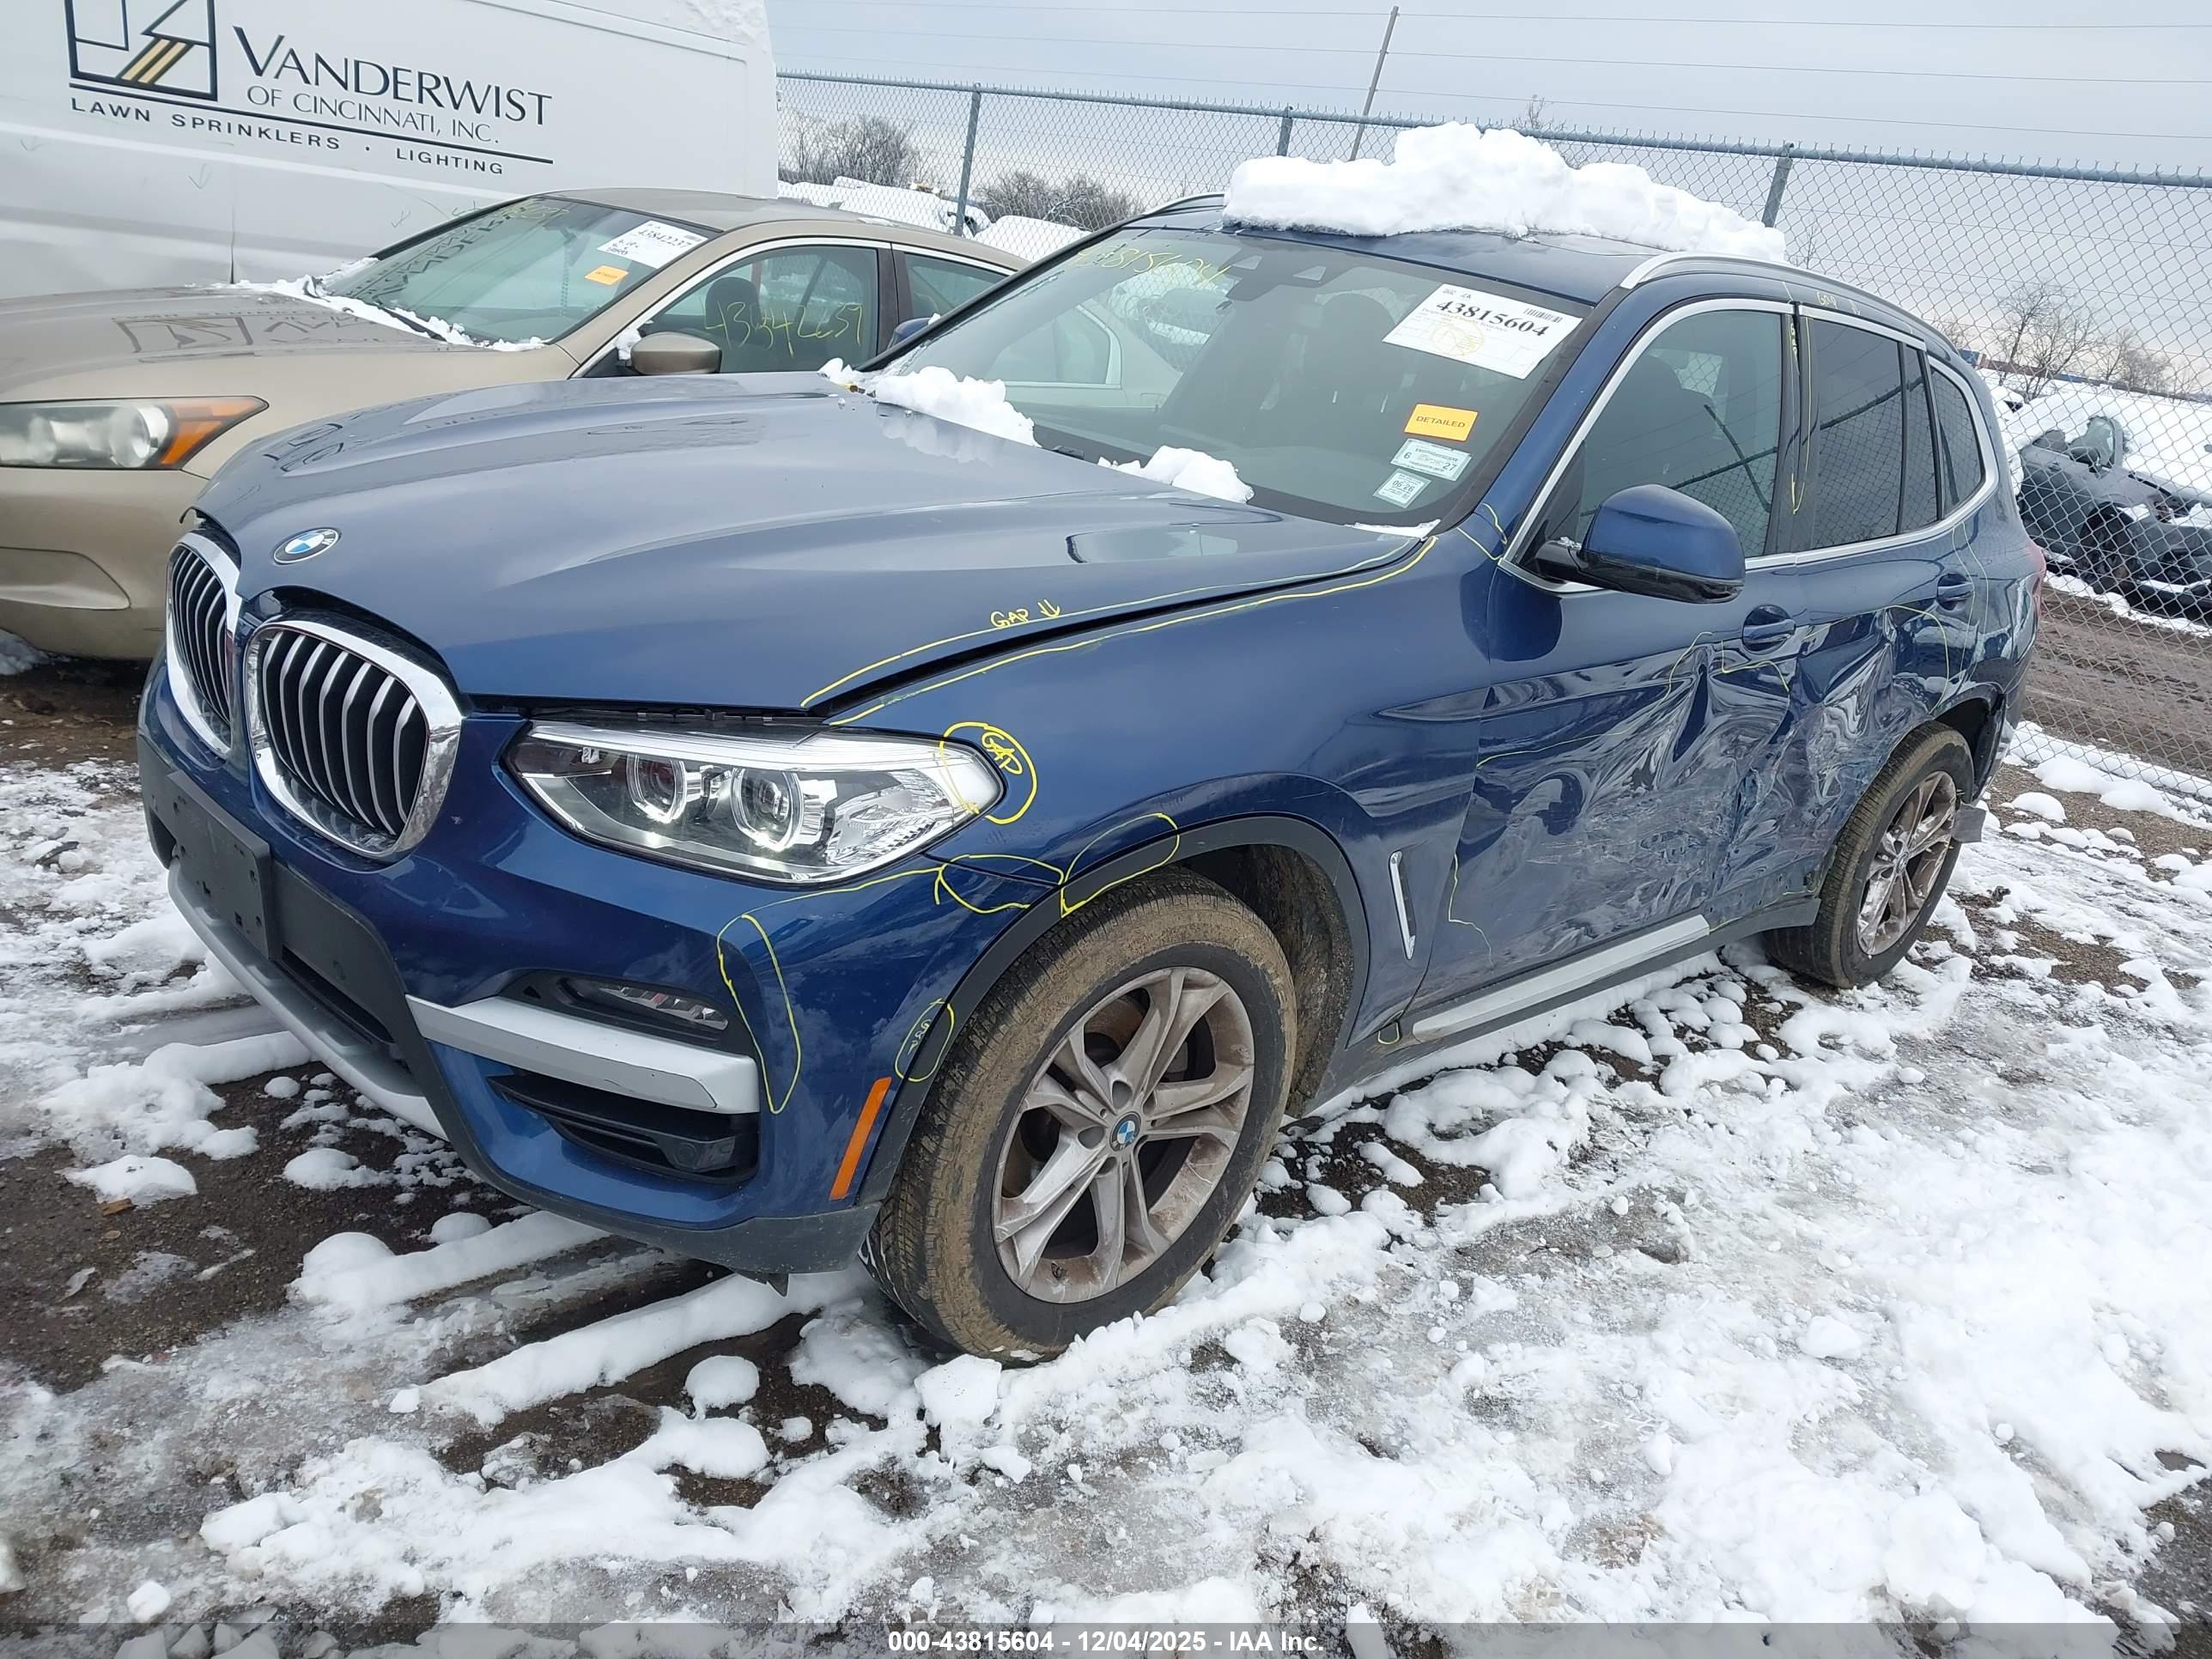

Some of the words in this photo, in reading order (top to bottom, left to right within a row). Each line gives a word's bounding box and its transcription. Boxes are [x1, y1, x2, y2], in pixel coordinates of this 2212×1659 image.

[233, 26, 553, 125] VANDERWIST
[71, 97, 151, 122] LAWN
[171, 113, 340, 149] SPRINKLERS
[397, 148, 502, 174] LIGHTING
[246, 85, 283, 107] OF
[293, 92, 441, 137] CINCINNATI,
[452, 118, 500, 143] INC.
[1436, 301, 1550, 337] 43815604
[1415, 416, 1466, 428] DETAILED
[1442, 462, 1457, 472] 27
